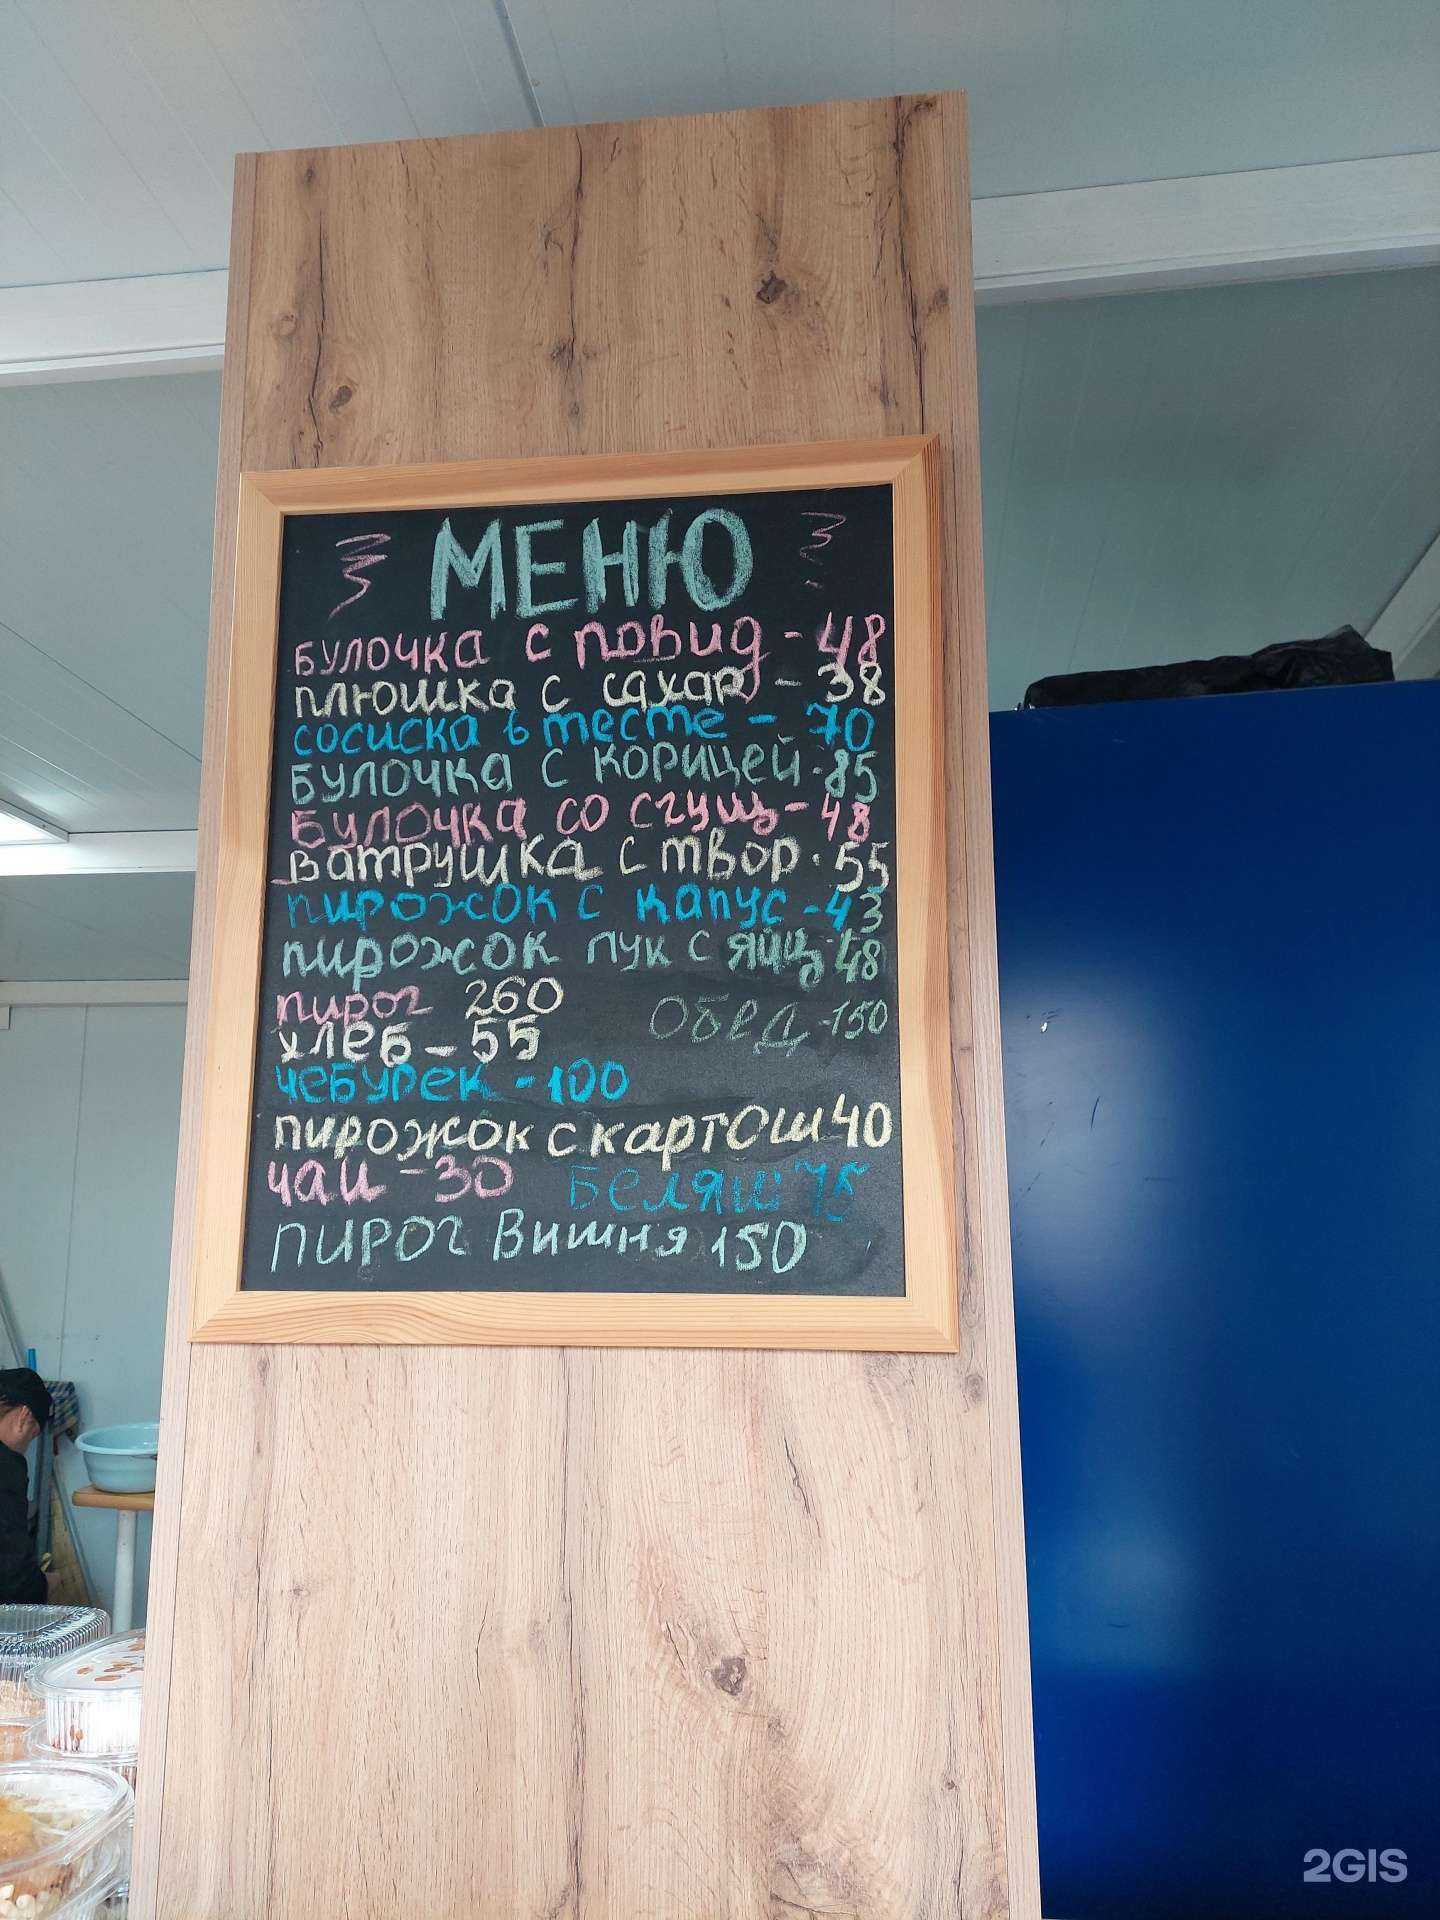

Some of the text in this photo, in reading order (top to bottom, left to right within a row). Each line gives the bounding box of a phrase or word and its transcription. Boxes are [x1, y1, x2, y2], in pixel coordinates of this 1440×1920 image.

[430, 508, 753, 622] МЕНЮ
[815, 611, 886, 666] 48
[294, 677, 518, 719] плюшка
[602, 665, 746, 712] сахар
[817, 661, 887, 707] 38
[293, 712, 482, 757] сосиска
[542, 703, 728, 747] тесте
[804, 701, 876, 752] 70
[592, 733, 801, 788] корицей
[820, 792, 871, 843] 48
[660, 826, 801, 884] твор
[833, 840, 890, 893] 55
[287, 882, 559, 932] пирожок
[636, 883, 789, 929] капус
[282, 930, 562, 993] пирожок
[586, 929, 674, 972] лук
[464, 975, 566, 1018] 260
[278, 1016, 414, 1068] хлеб
[470, 1013, 543, 1064] 55
[275, 1060, 500, 1105] чебурек
[546, 1056, 632, 1105] 100
[273, 1114, 535, 1162] пирожок
[831, 1092, 894, 1150] 40
[433, 1152, 515, 1204] 30
[710, 1218, 809, 1275] 150
